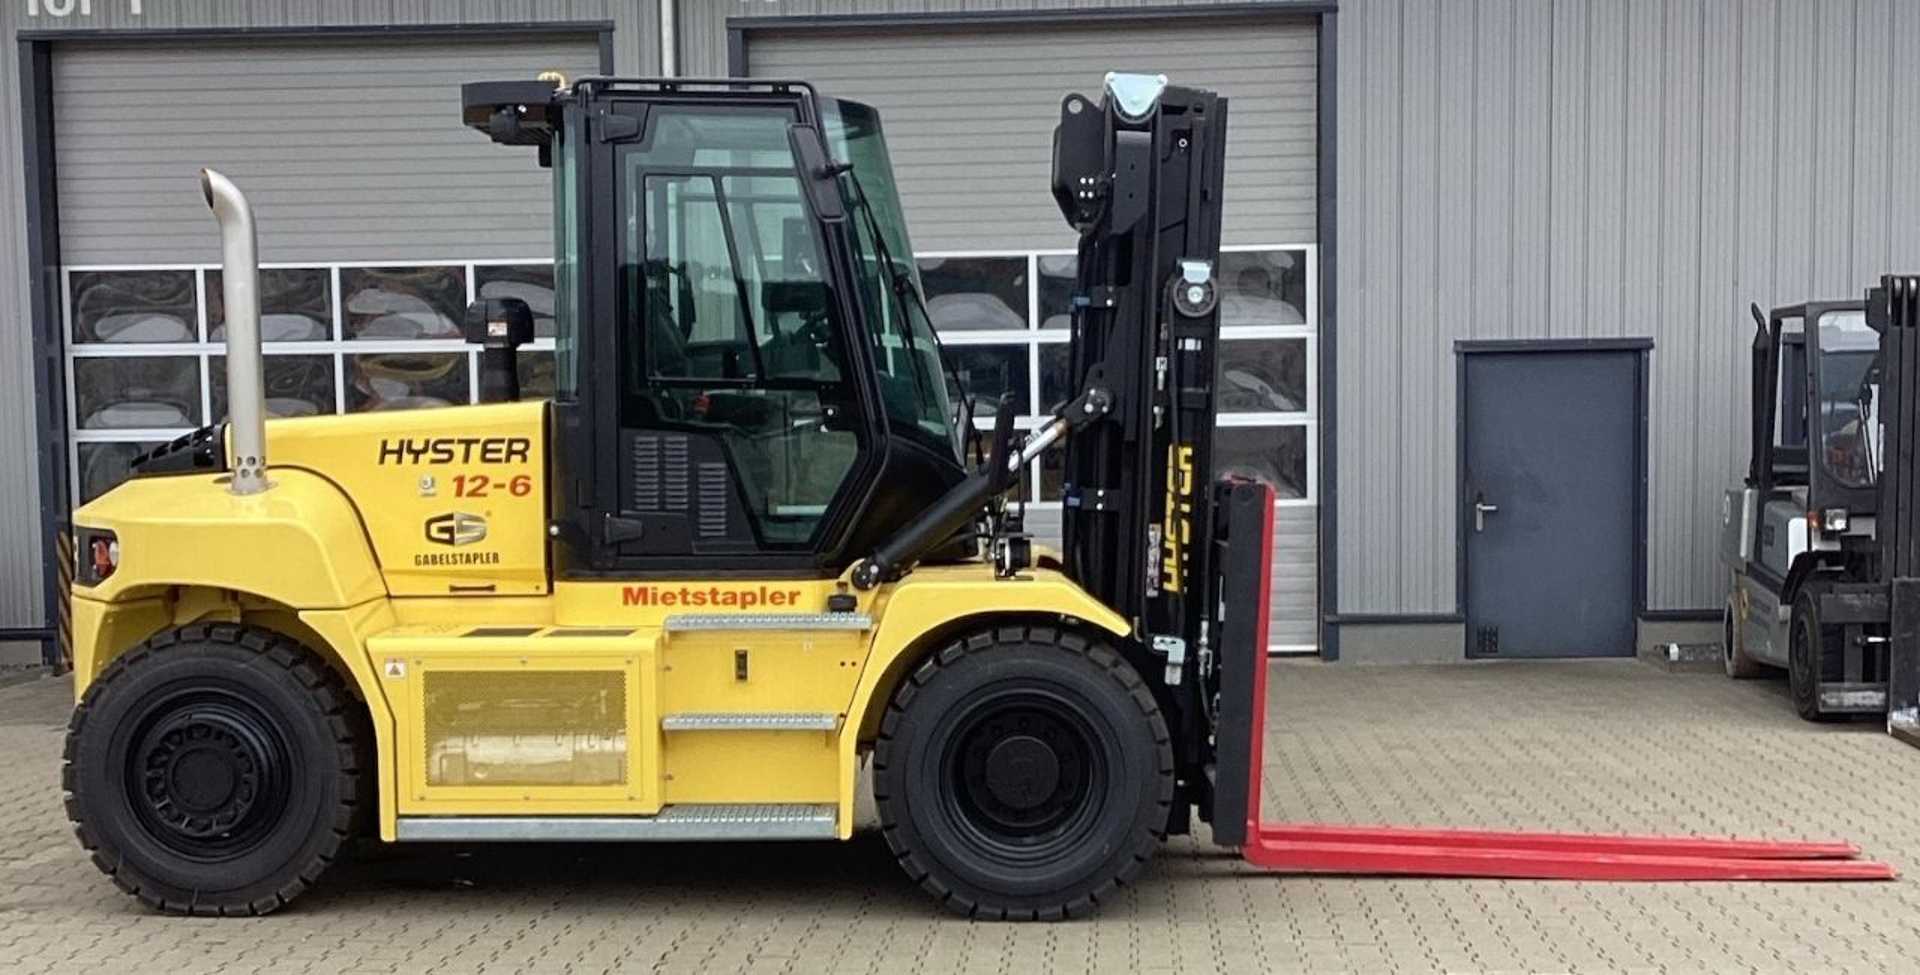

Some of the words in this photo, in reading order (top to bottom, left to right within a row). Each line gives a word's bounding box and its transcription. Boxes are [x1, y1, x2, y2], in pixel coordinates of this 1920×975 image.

[378, 438, 531, 465] HYSTER
[452, 475, 532, 498] 12-6
[414, 552, 500, 566] GABELSTAPLER
[622, 586, 802, 610] Mietstapler
